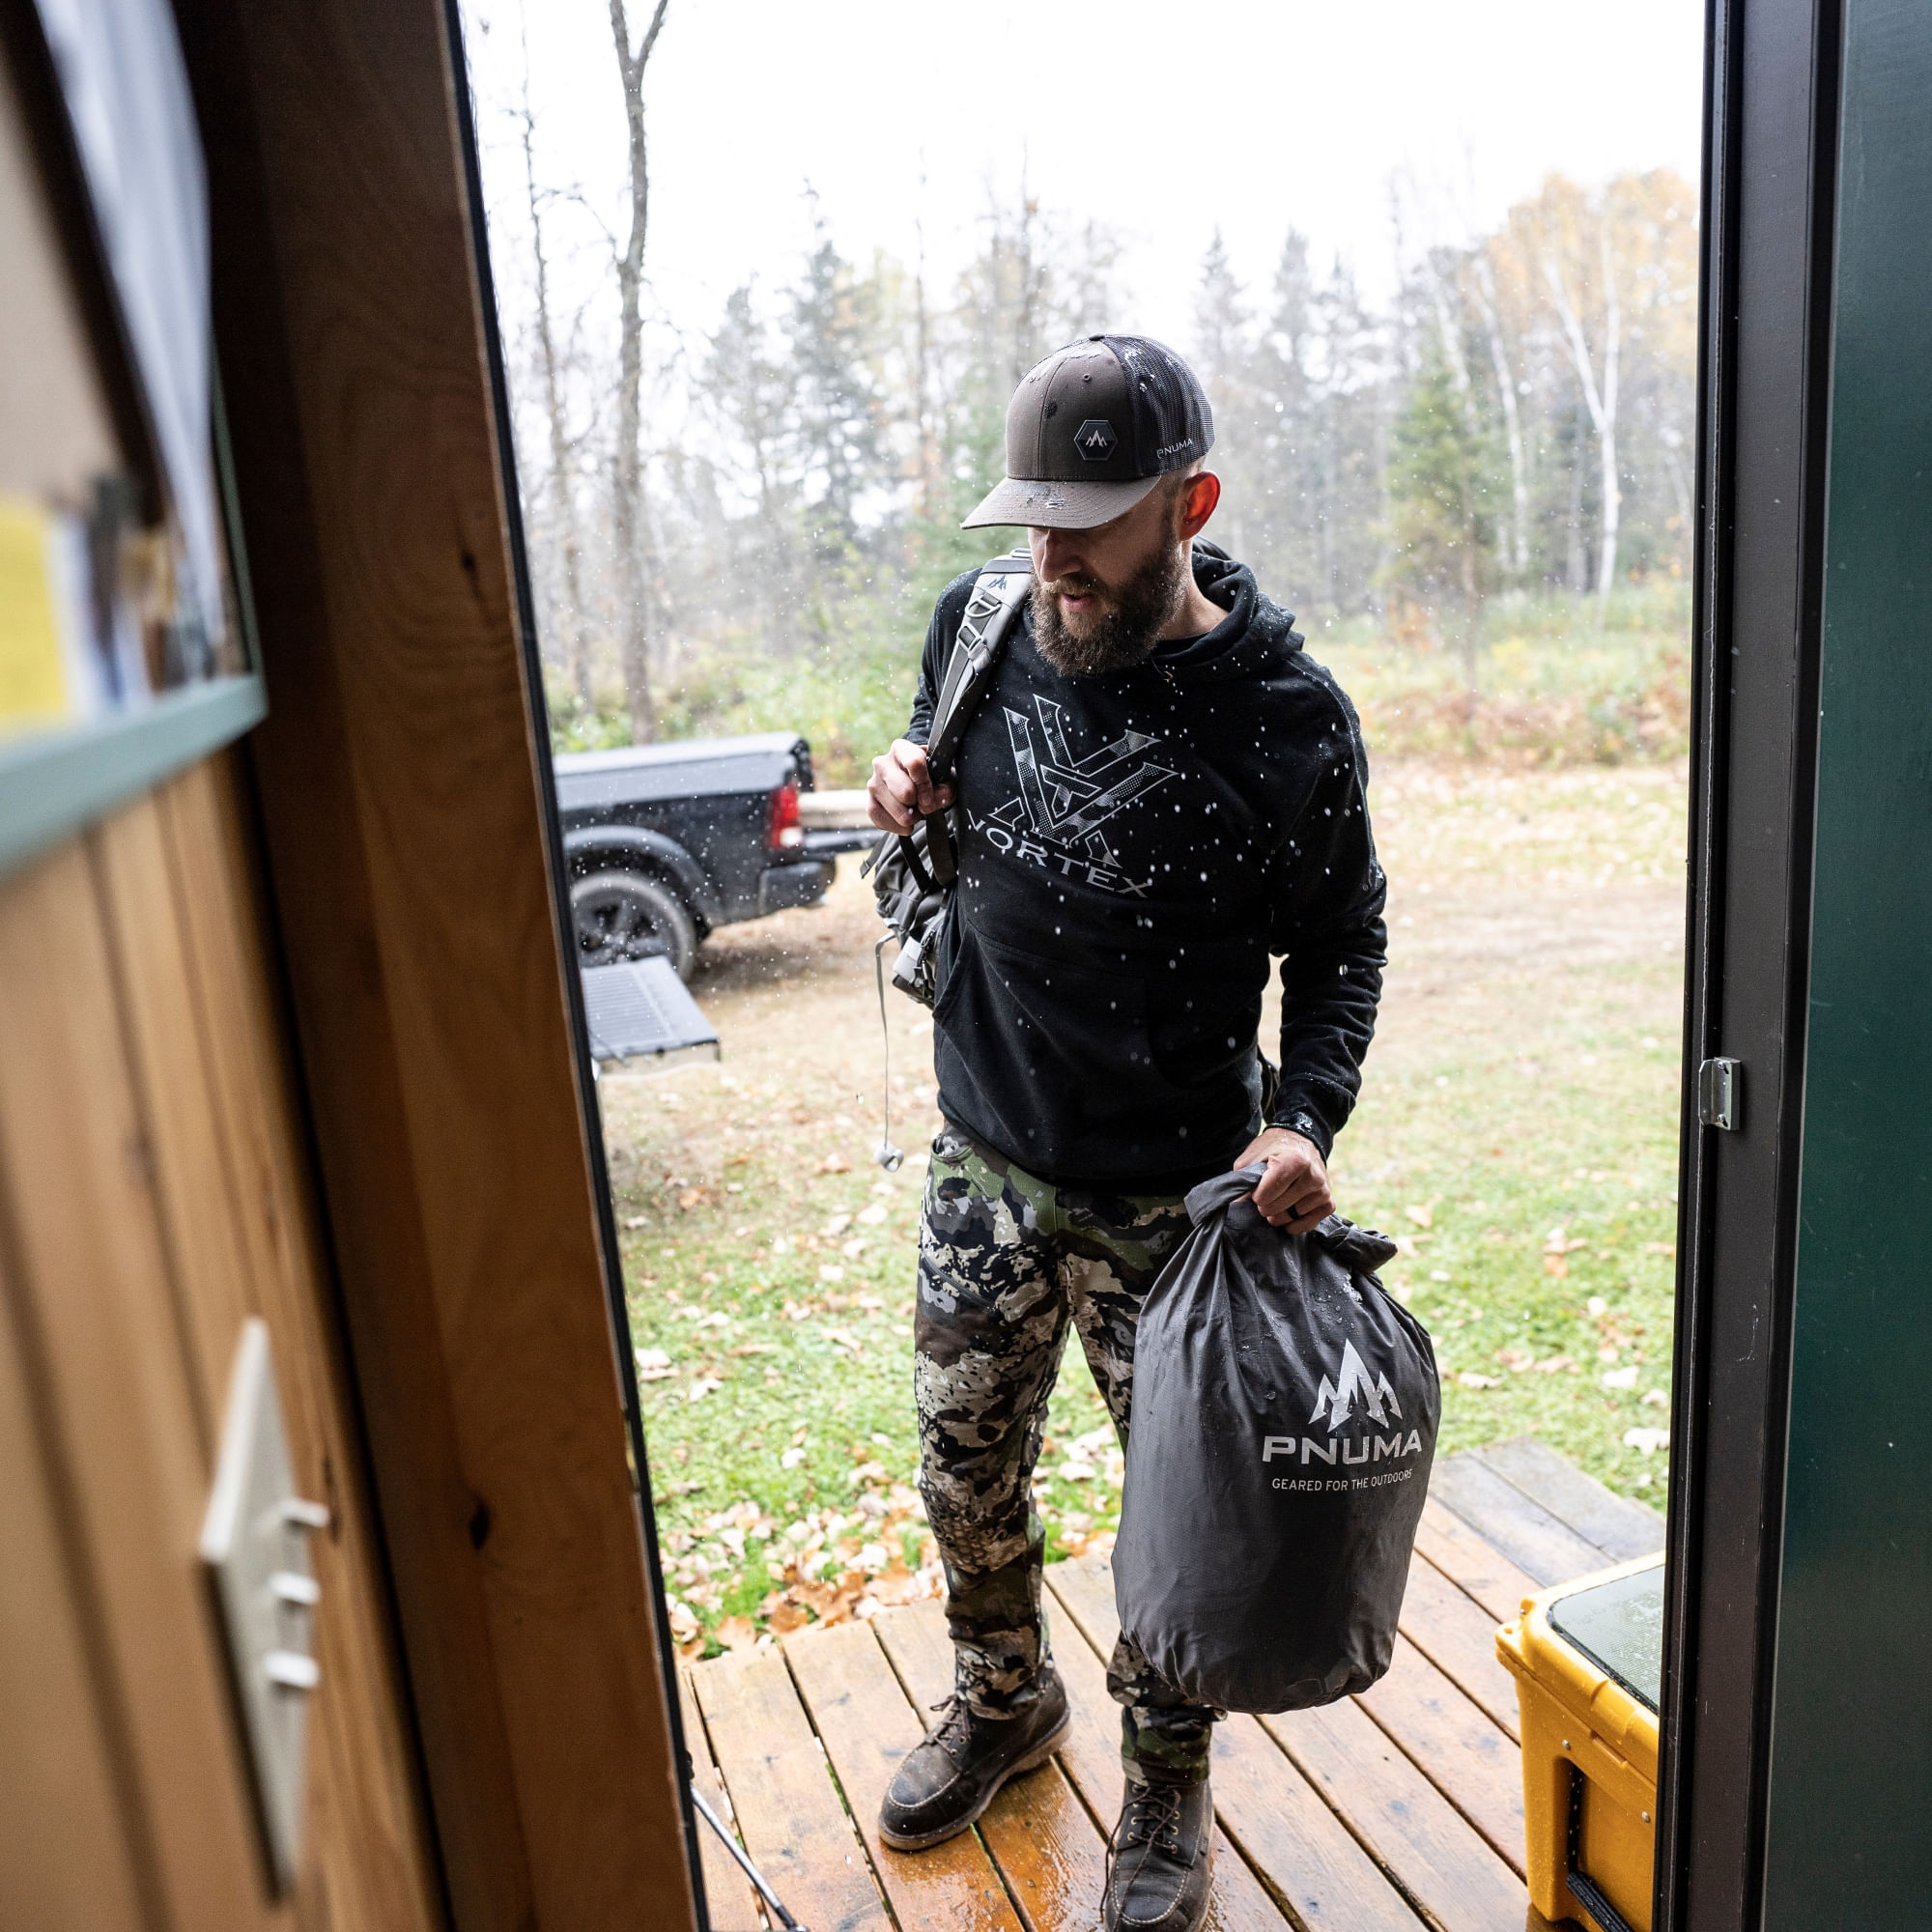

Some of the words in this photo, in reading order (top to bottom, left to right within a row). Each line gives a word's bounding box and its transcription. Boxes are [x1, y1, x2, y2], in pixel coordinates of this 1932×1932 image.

[1156, 438, 1193, 459] PNUMA
[967, 808, 1153, 898] VORTEX
[1262, 1429, 1423, 1465] PNUMA
[1271, 1478, 1322, 1492] GEARED
[1325, 1480, 1349, 1492] FOR
[1351, 1477, 1369, 1491] THE
[1371, 1468, 1413, 1487] OUTDOORS
